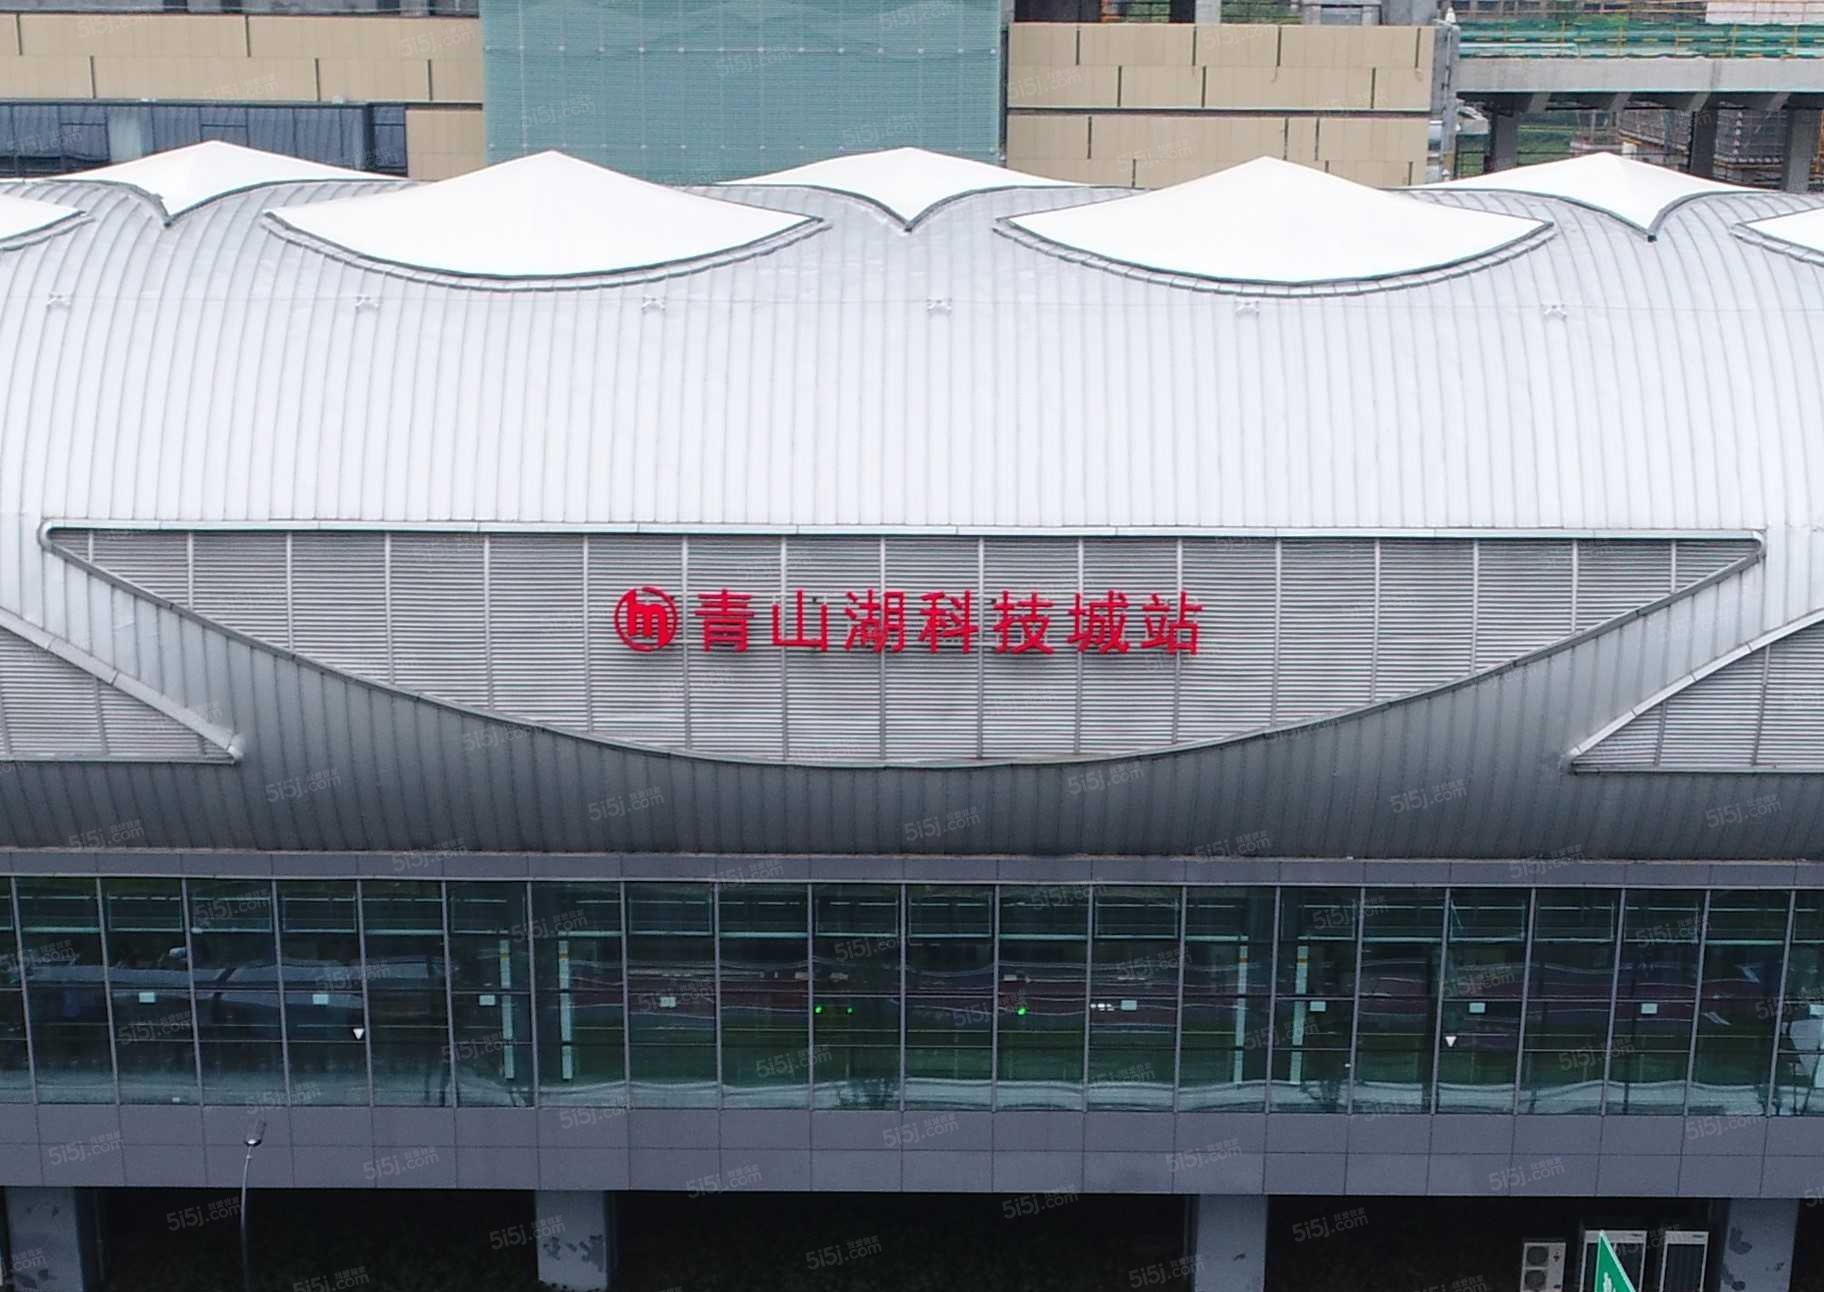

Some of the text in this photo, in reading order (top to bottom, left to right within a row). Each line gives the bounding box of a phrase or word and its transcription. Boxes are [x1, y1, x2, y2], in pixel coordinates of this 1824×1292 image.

[694, 588, 1205, 655] 青山湖科技城站
